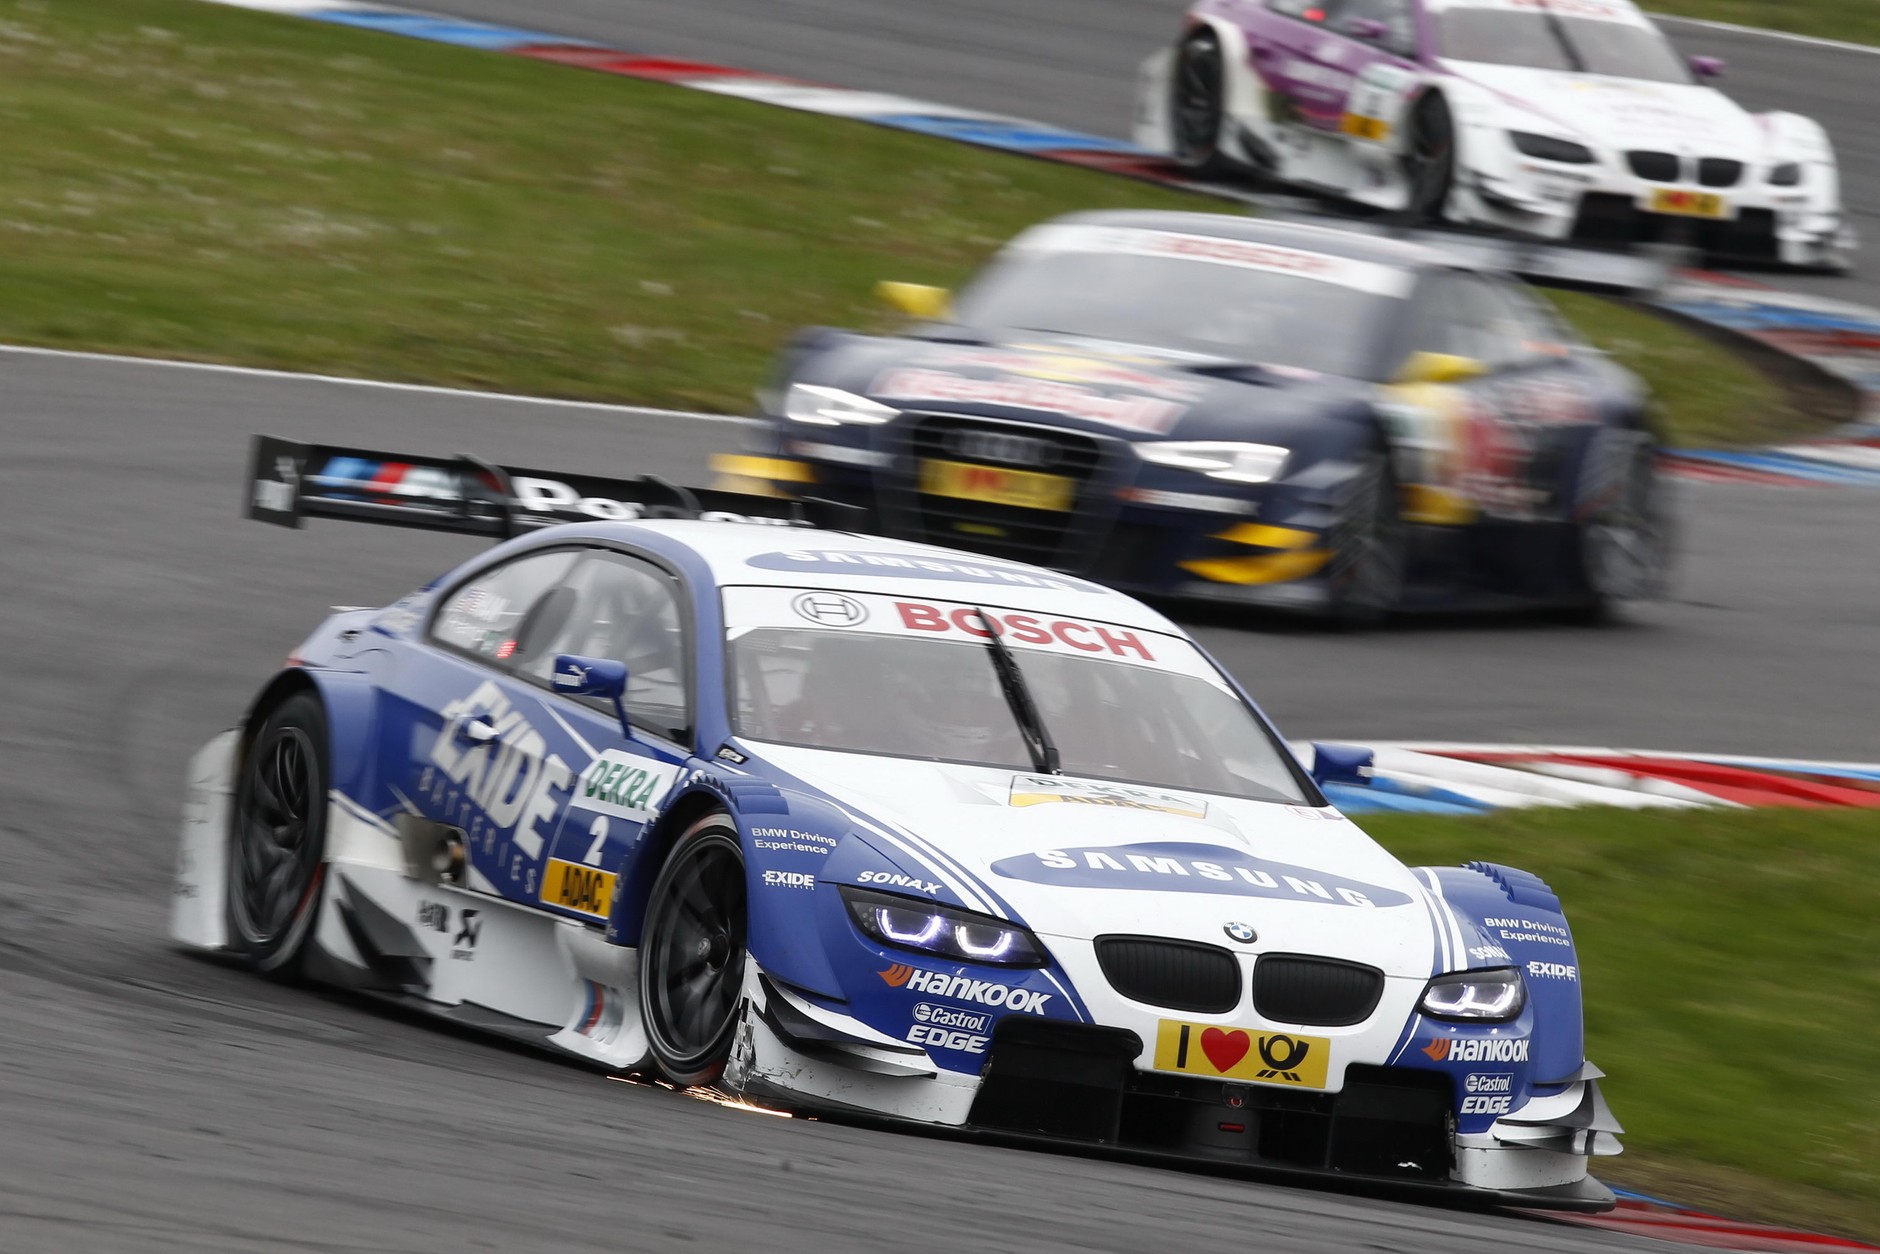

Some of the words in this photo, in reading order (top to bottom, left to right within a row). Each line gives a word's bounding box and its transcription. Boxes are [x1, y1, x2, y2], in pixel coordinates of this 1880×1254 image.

[893, 601, 1157, 662] BOSCH
[430, 680, 574, 861] EXIDE
[586, 759, 662, 811] DEKRA
[582, 815, 610, 867] 2
[751, 827, 788, 839] BMW
[790, 829, 838, 847] Driving
[754, 839, 829, 855] Experience
[764, 870, 815, 887] EXIDE
[857, 870, 943, 895] SONAX
[1033, 849, 1377, 908] SAMSUNG
[1484, 917, 1520, 929] BMW
[1522, 919, 1567, 937] Driving
[1499, 929, 1571, 947] Experience
[1529, 960, 1576, 978] EXIDE
[930, 1007, 986, 1031] Castrol
[905, 1024, 991, 1054] EDGE
[1176, 1024, 1191, 1069] I
[1477, 1075, 1511, 1092] Castrol
[1460, 1095, 1513, 1114] EDGE
